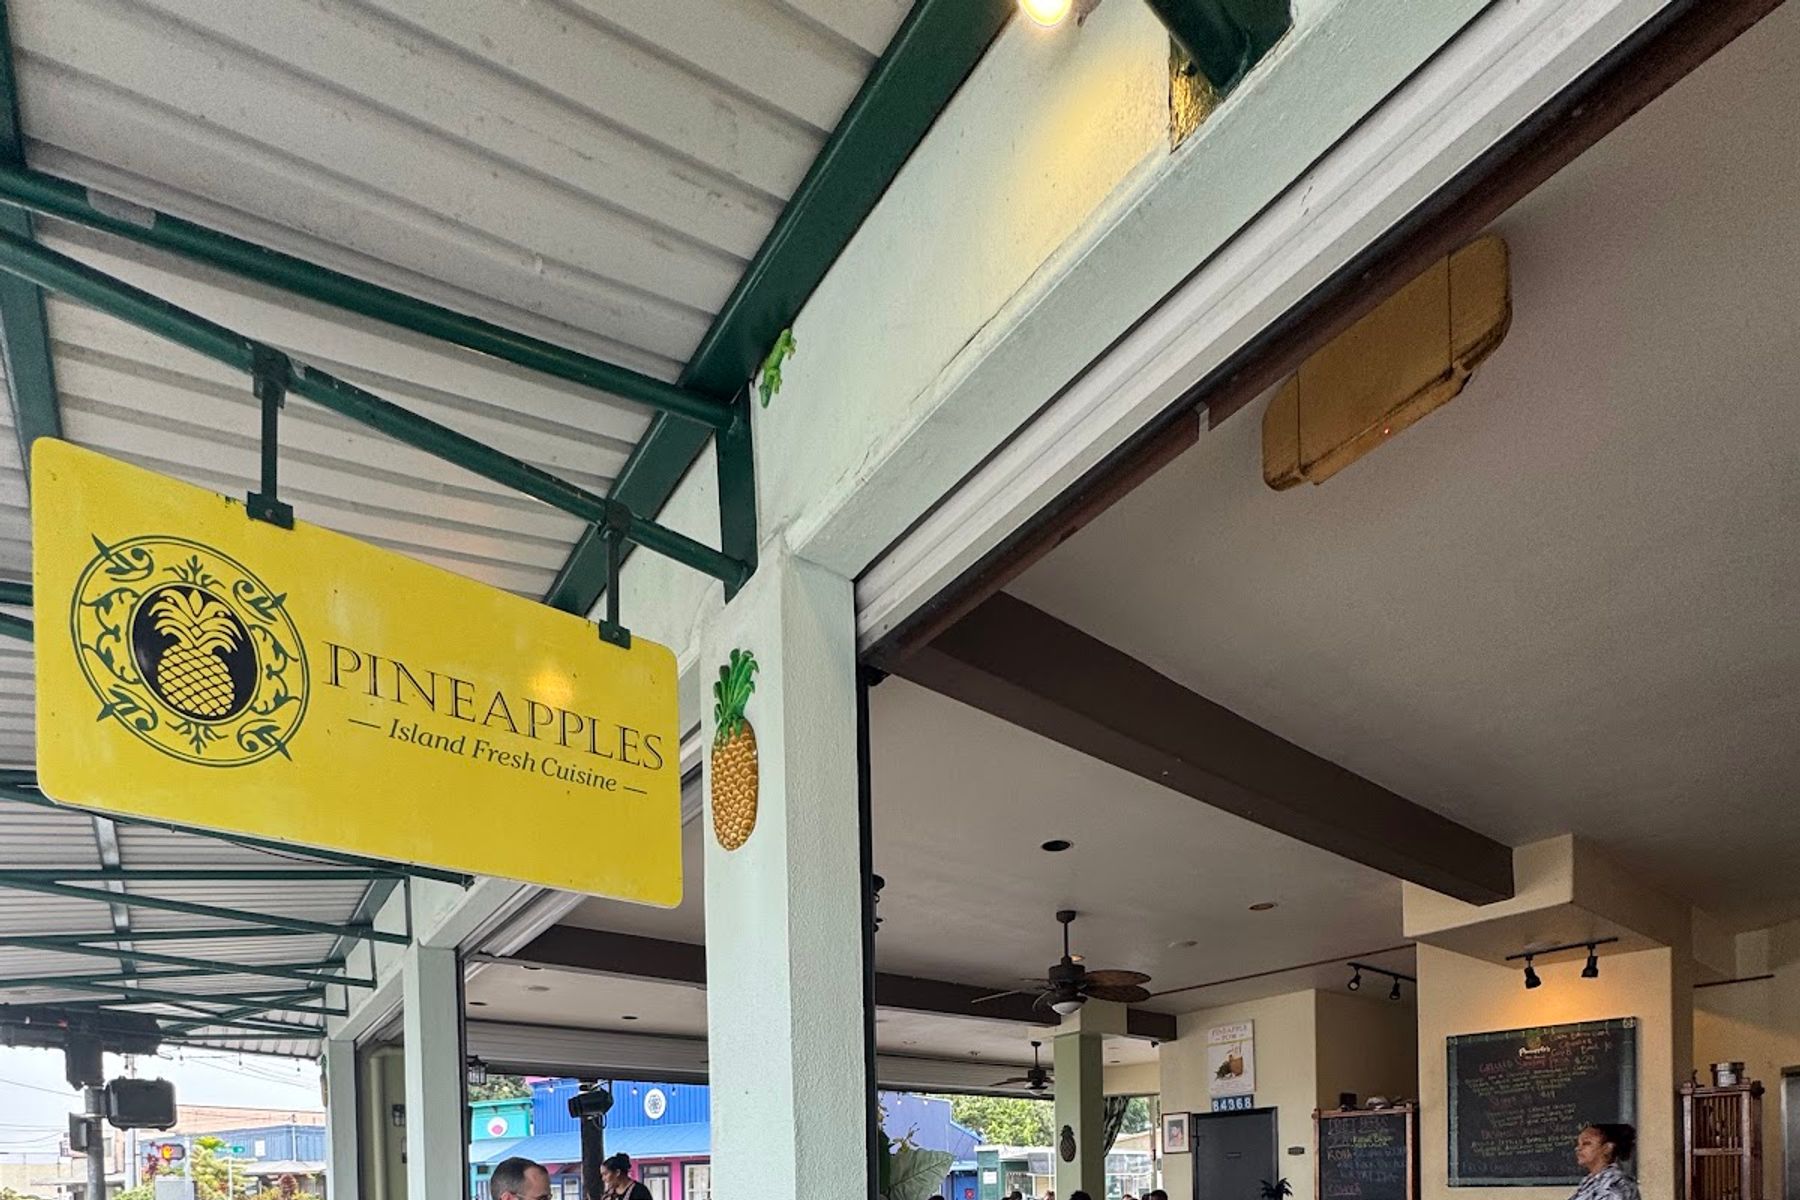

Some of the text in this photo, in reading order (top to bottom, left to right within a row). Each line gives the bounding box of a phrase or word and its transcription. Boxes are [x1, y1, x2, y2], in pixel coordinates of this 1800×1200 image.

[322, 640, 664, 772] PINEAPPLES
[388, 717, 618, 792] Island Fresh Cuisine
